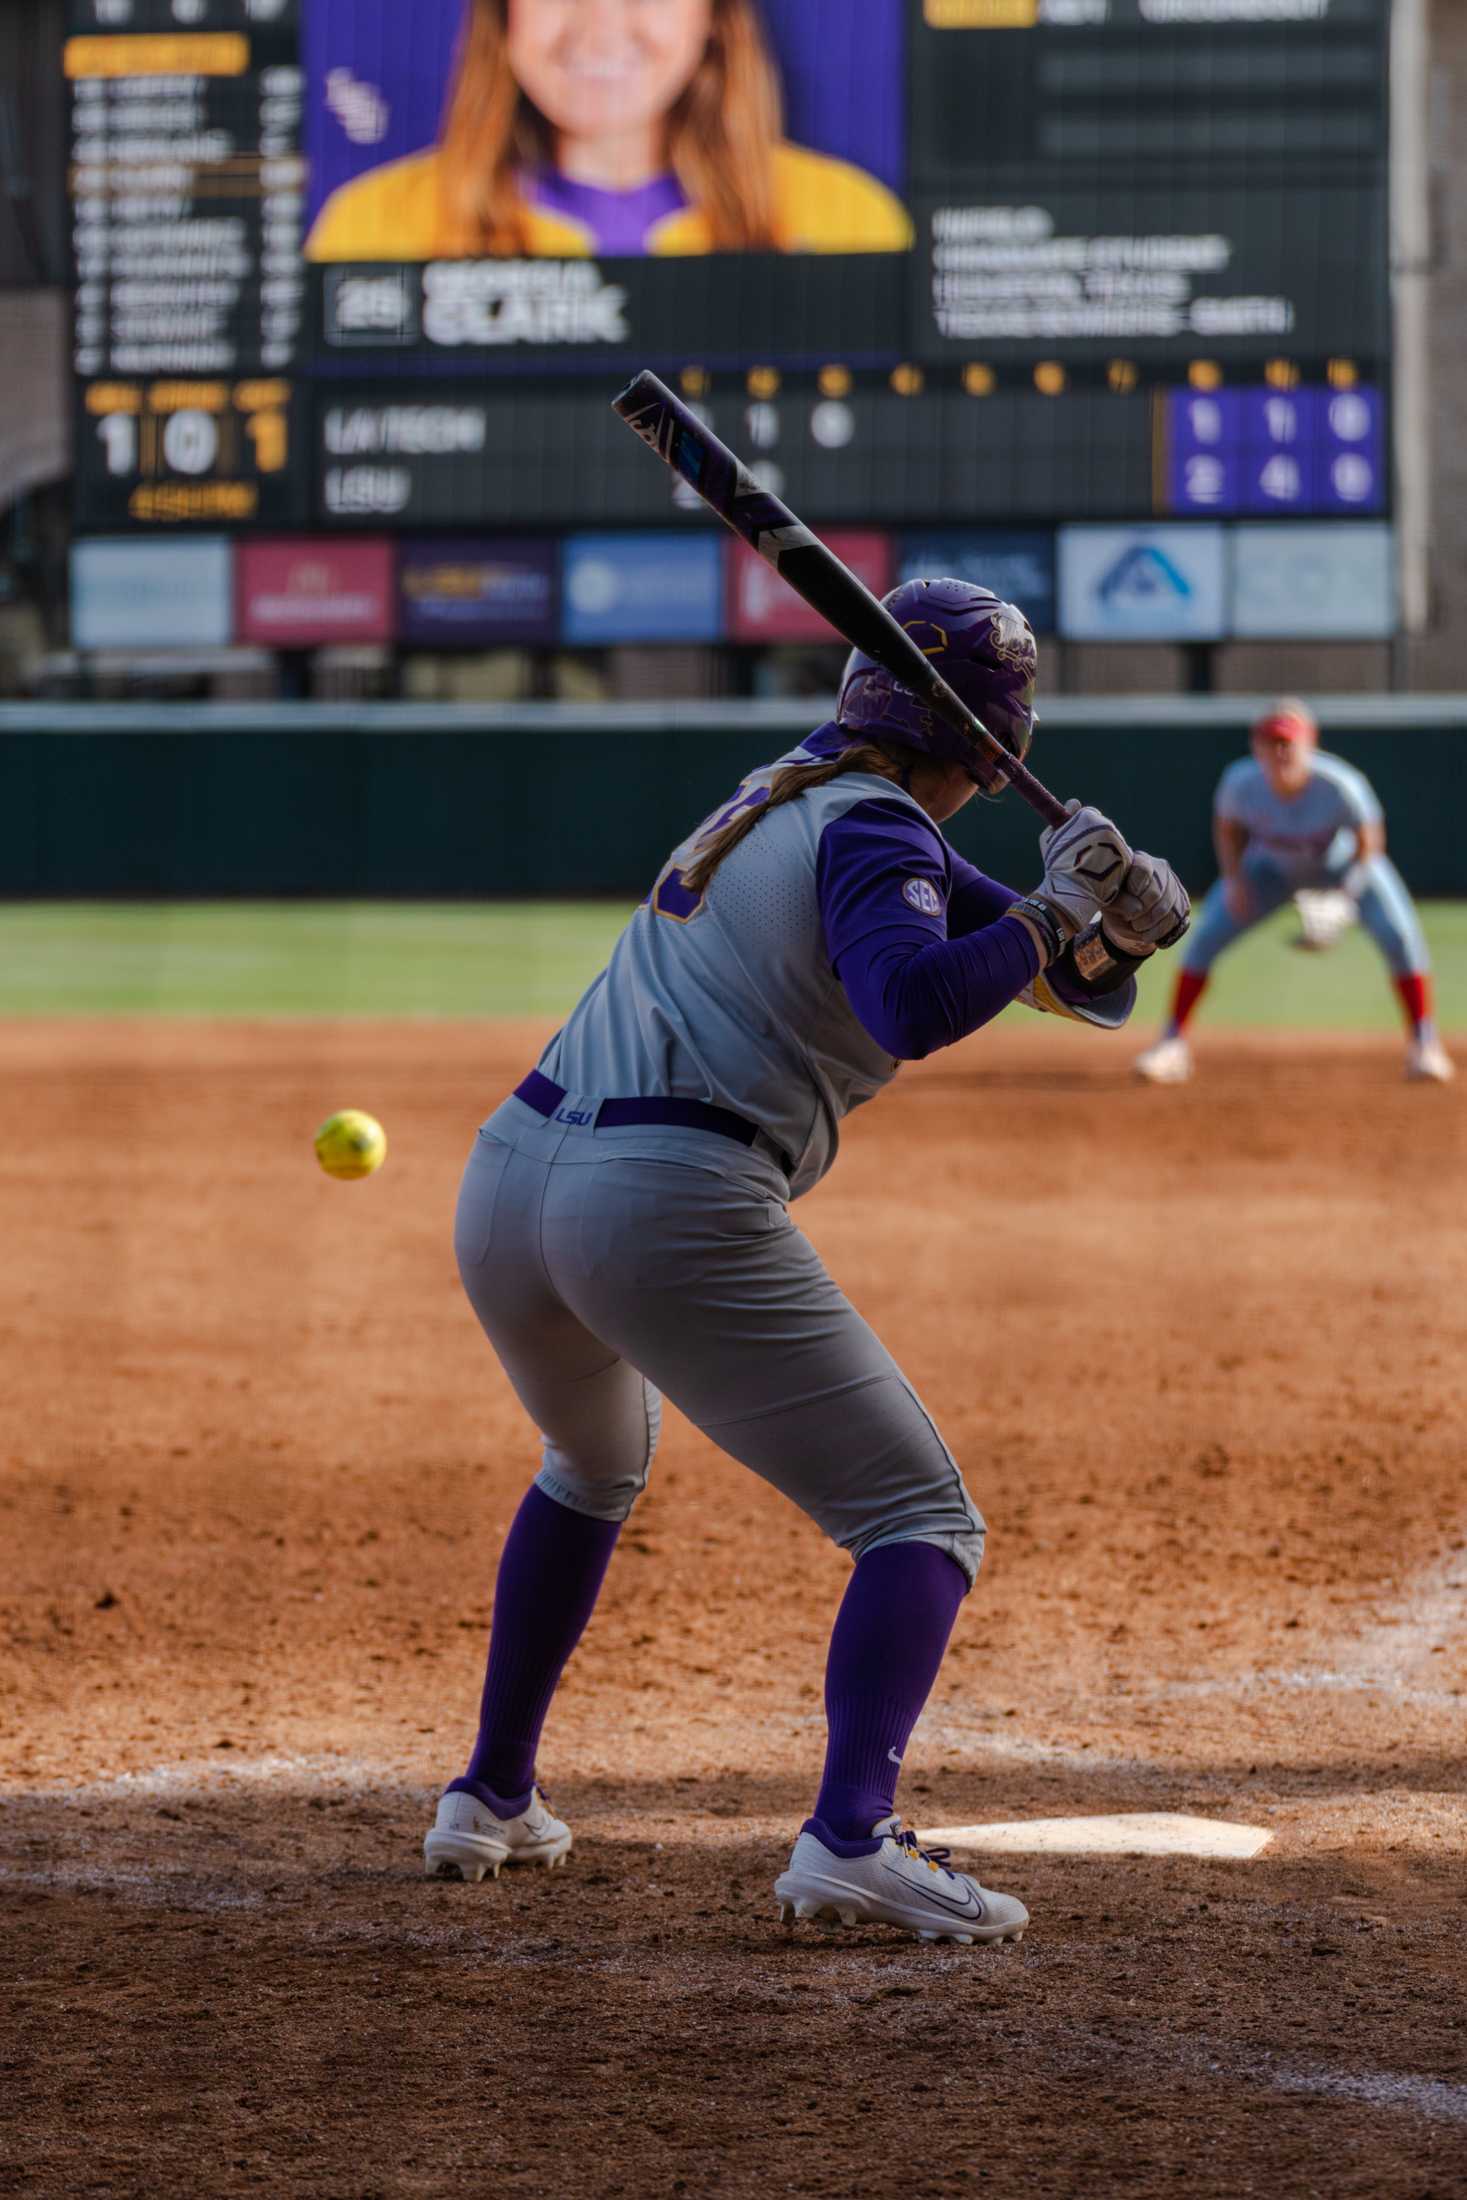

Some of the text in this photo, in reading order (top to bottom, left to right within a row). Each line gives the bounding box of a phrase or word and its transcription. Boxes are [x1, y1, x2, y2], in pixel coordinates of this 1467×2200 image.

[96, 409, 289, 477] 1 0 1
[555, 1108, 593, 1126] LSU
